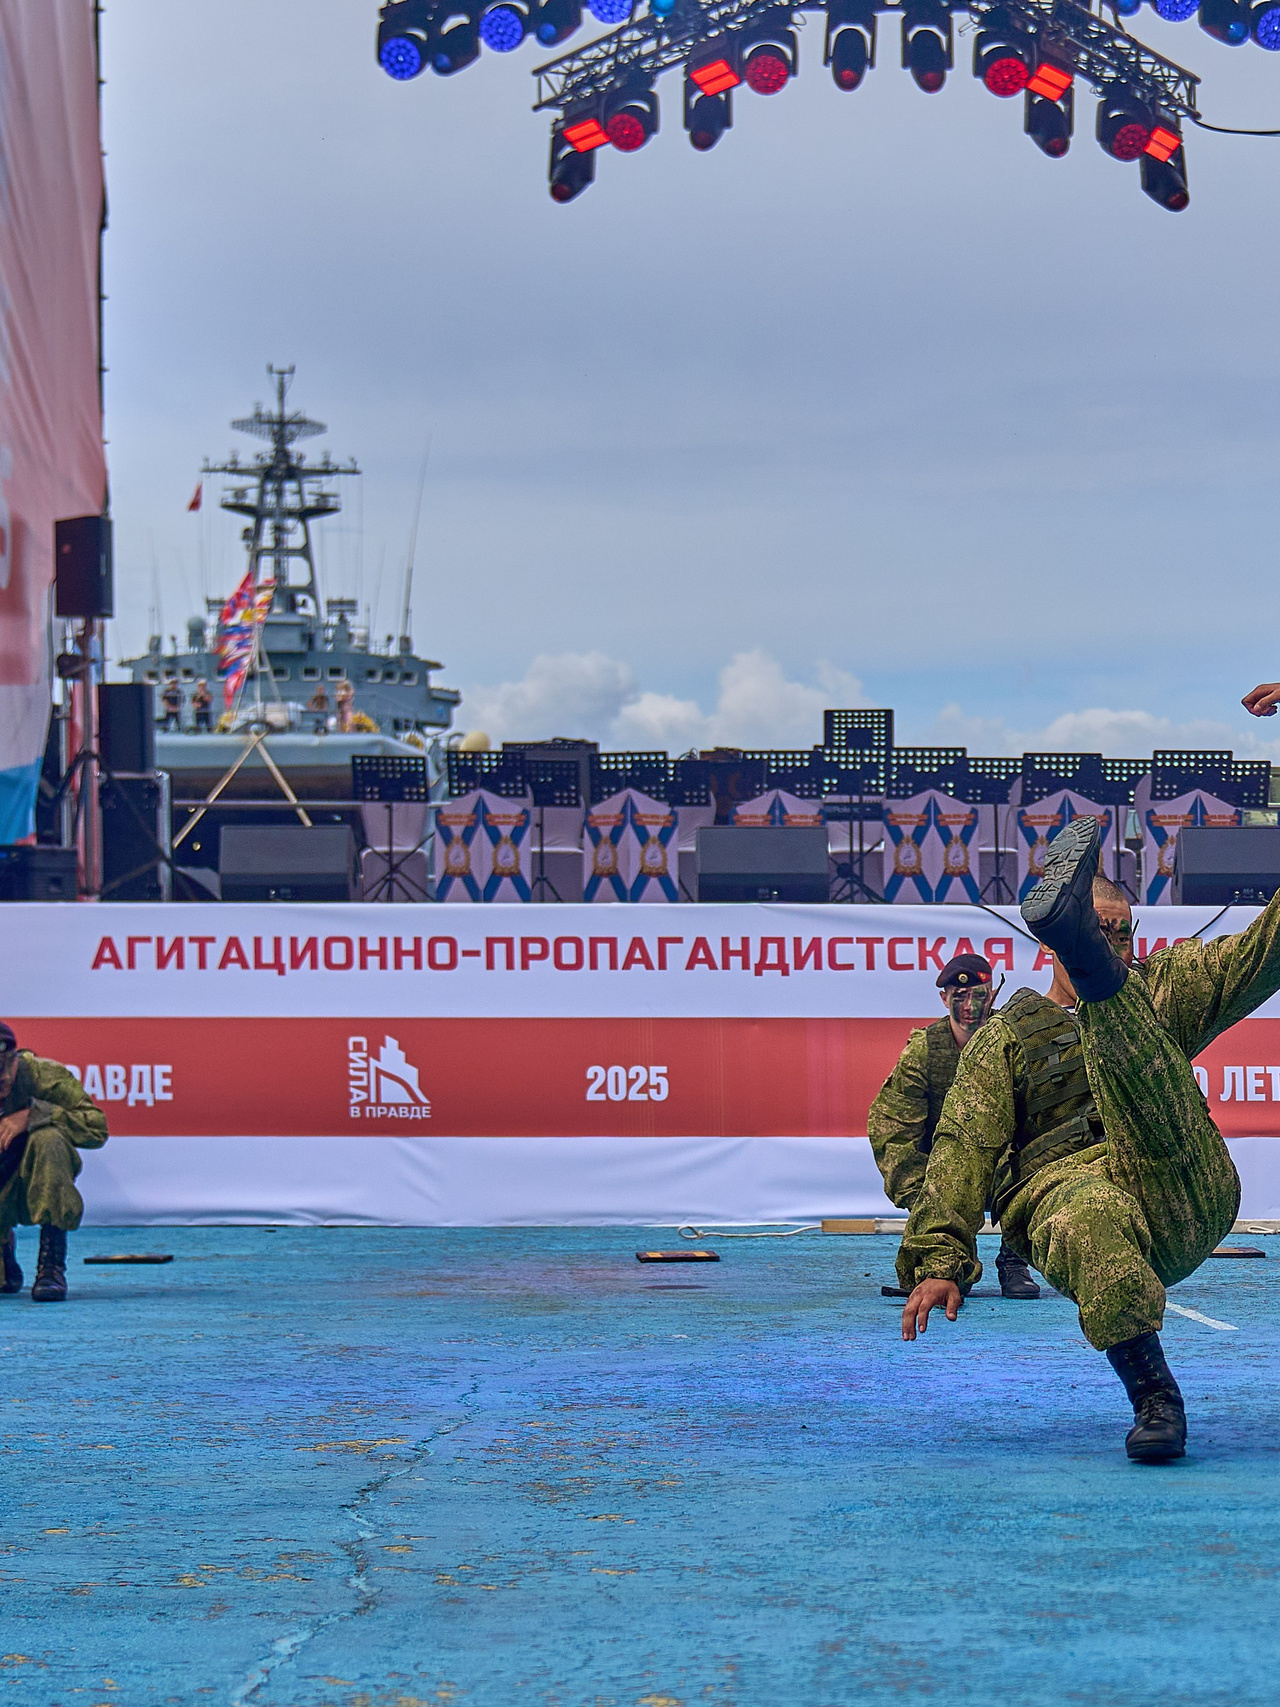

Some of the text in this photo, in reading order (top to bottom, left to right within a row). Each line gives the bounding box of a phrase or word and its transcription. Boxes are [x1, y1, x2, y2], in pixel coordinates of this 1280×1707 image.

[348, 1036, 368, 1104] СИЛА
[586, 1065, 669, 1101] 2025
[350, 1106, 432, 1119] В ПРАВДЕ
